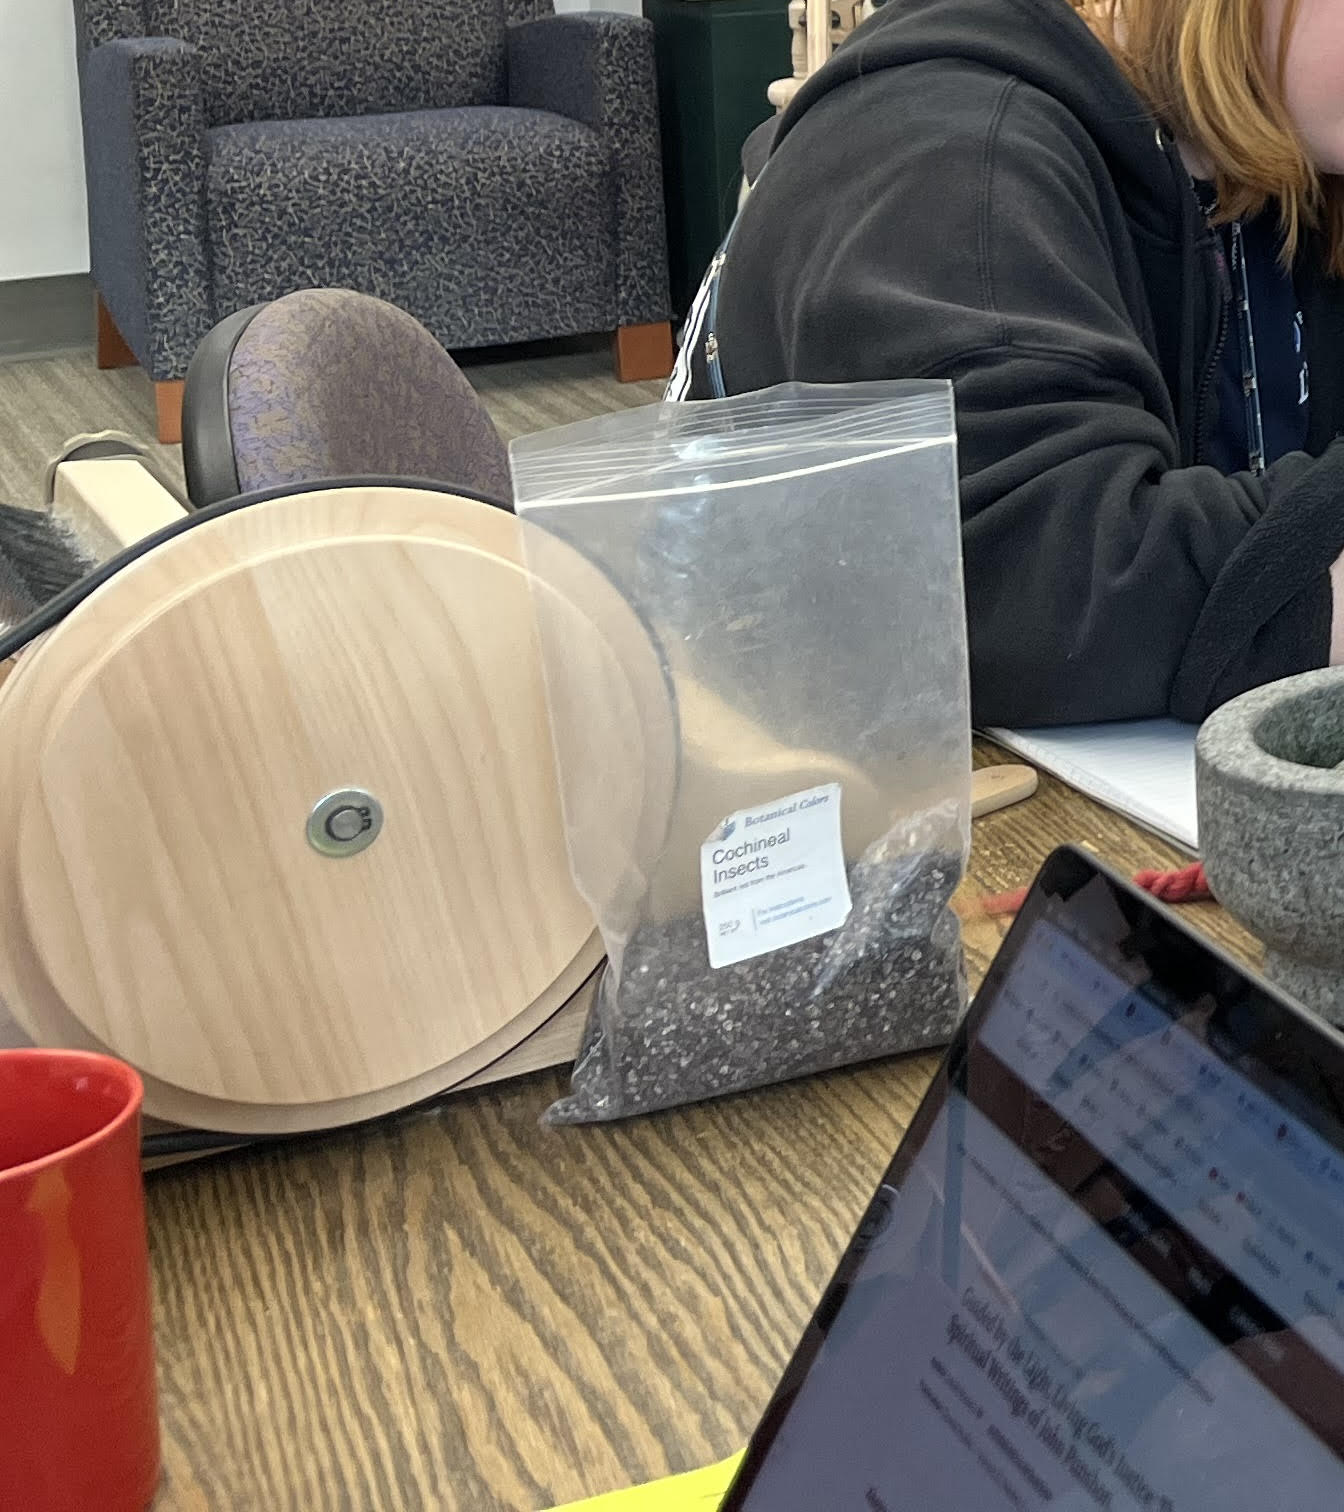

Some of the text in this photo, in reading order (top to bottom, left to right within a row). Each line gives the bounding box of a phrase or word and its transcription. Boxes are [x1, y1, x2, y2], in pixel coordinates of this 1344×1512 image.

[744, 794, 830, 828] Botanical Colors
[712, 828, 790, 865] Cochineal
[713, 855, 769, 884] Insects
